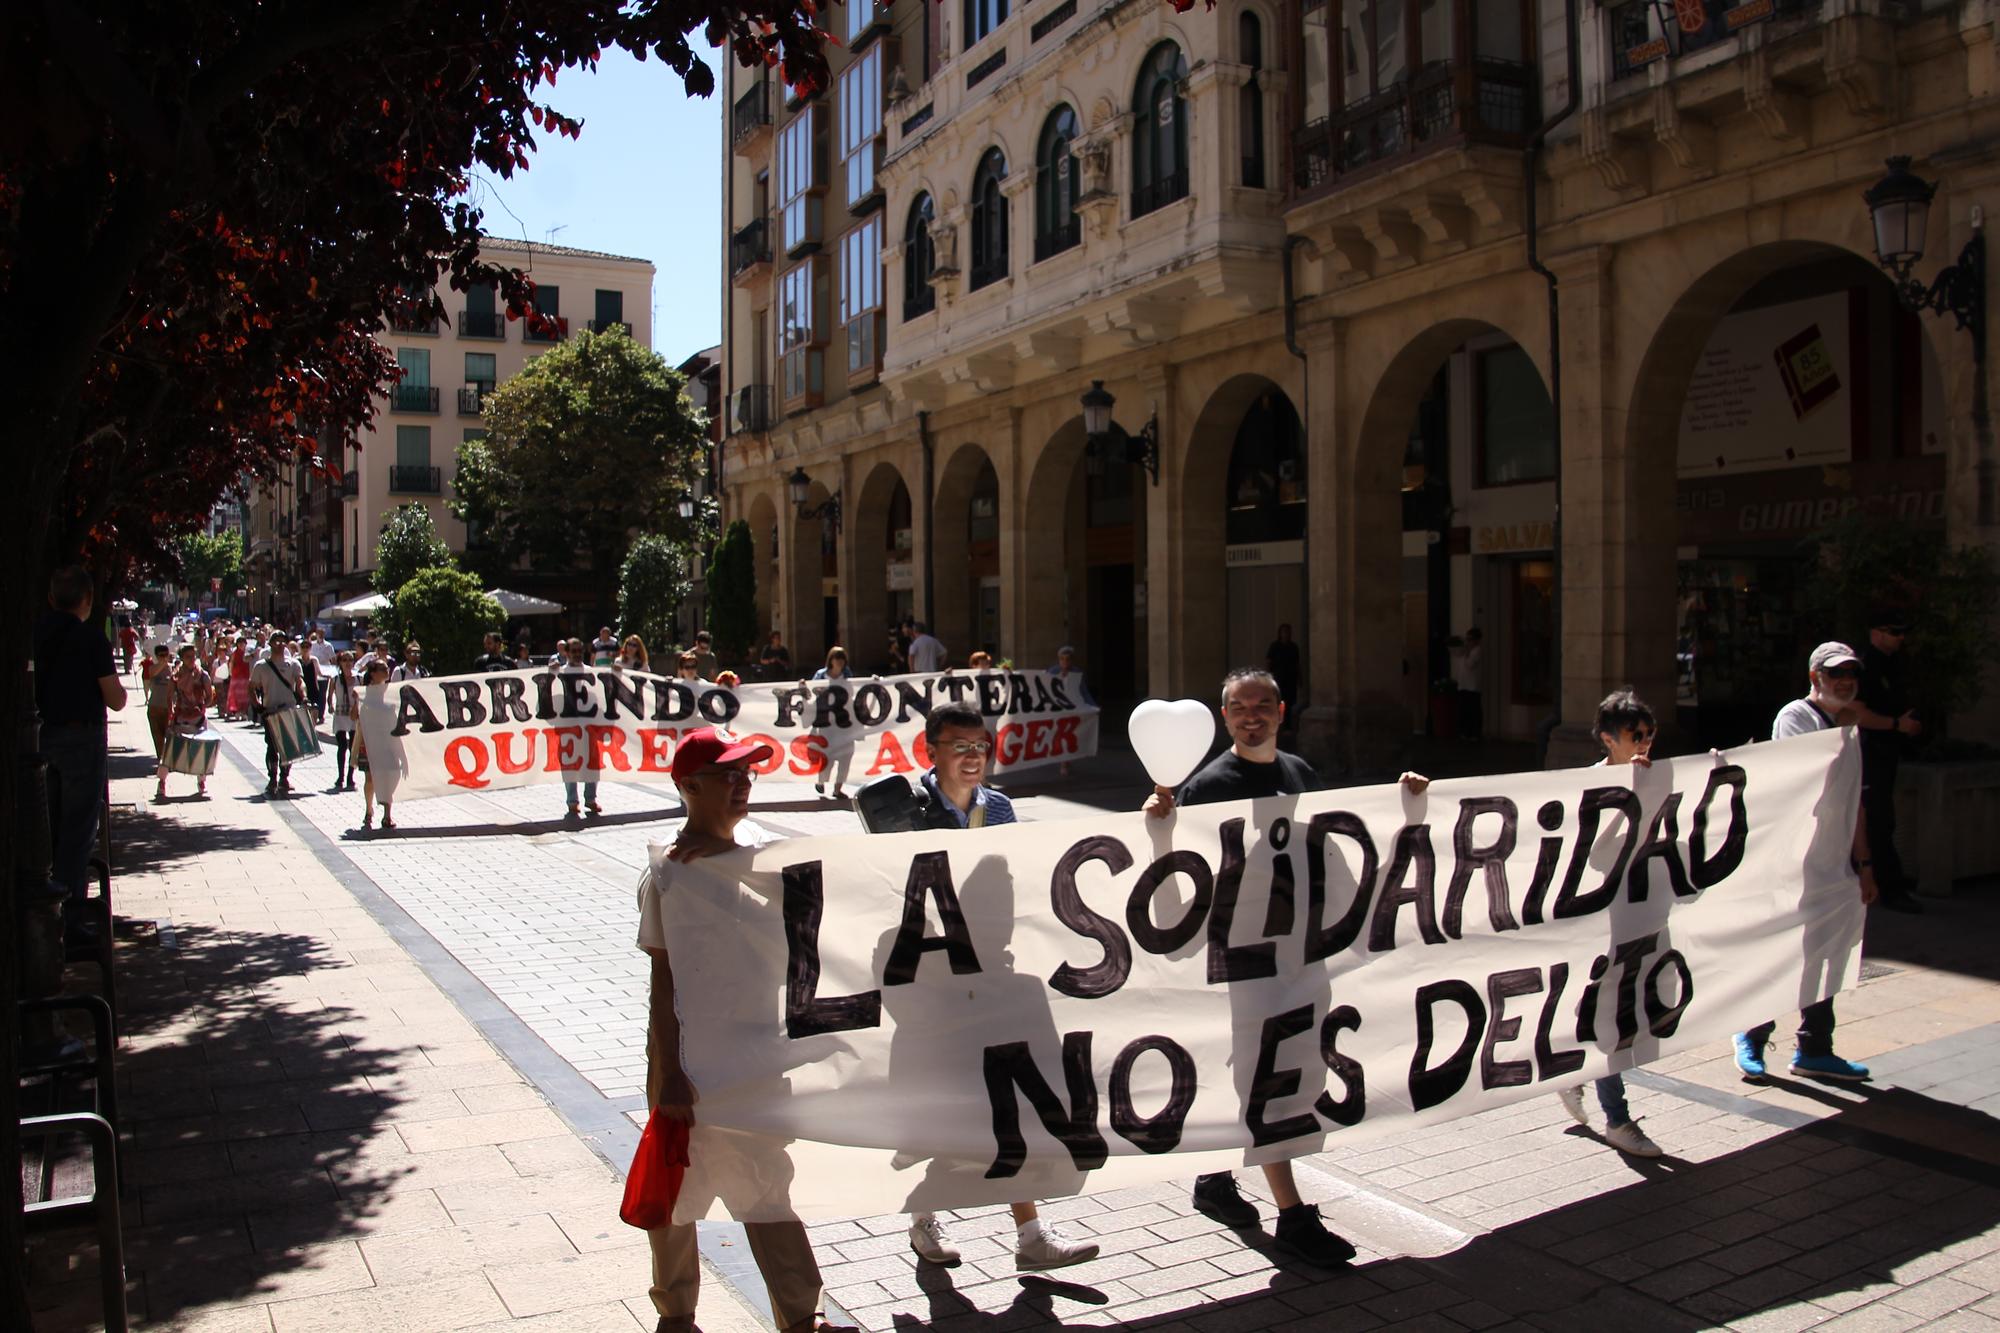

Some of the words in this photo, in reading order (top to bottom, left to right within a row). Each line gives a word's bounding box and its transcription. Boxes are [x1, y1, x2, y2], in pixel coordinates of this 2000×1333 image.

[1801, 346, 1820, 370] 85
[391, 673, 741, 736] ABRIENDO
[772, 674, 1076, 729] FRONTERAS
[444, 724, 828, 789] QUEREOS
[865, 716, 1080, 776] ACGER
[782, 850, 983, 1039] LA
[984, 1031, 1197, 1179] NO
[1245, 1004, 1365, 1148] ES
